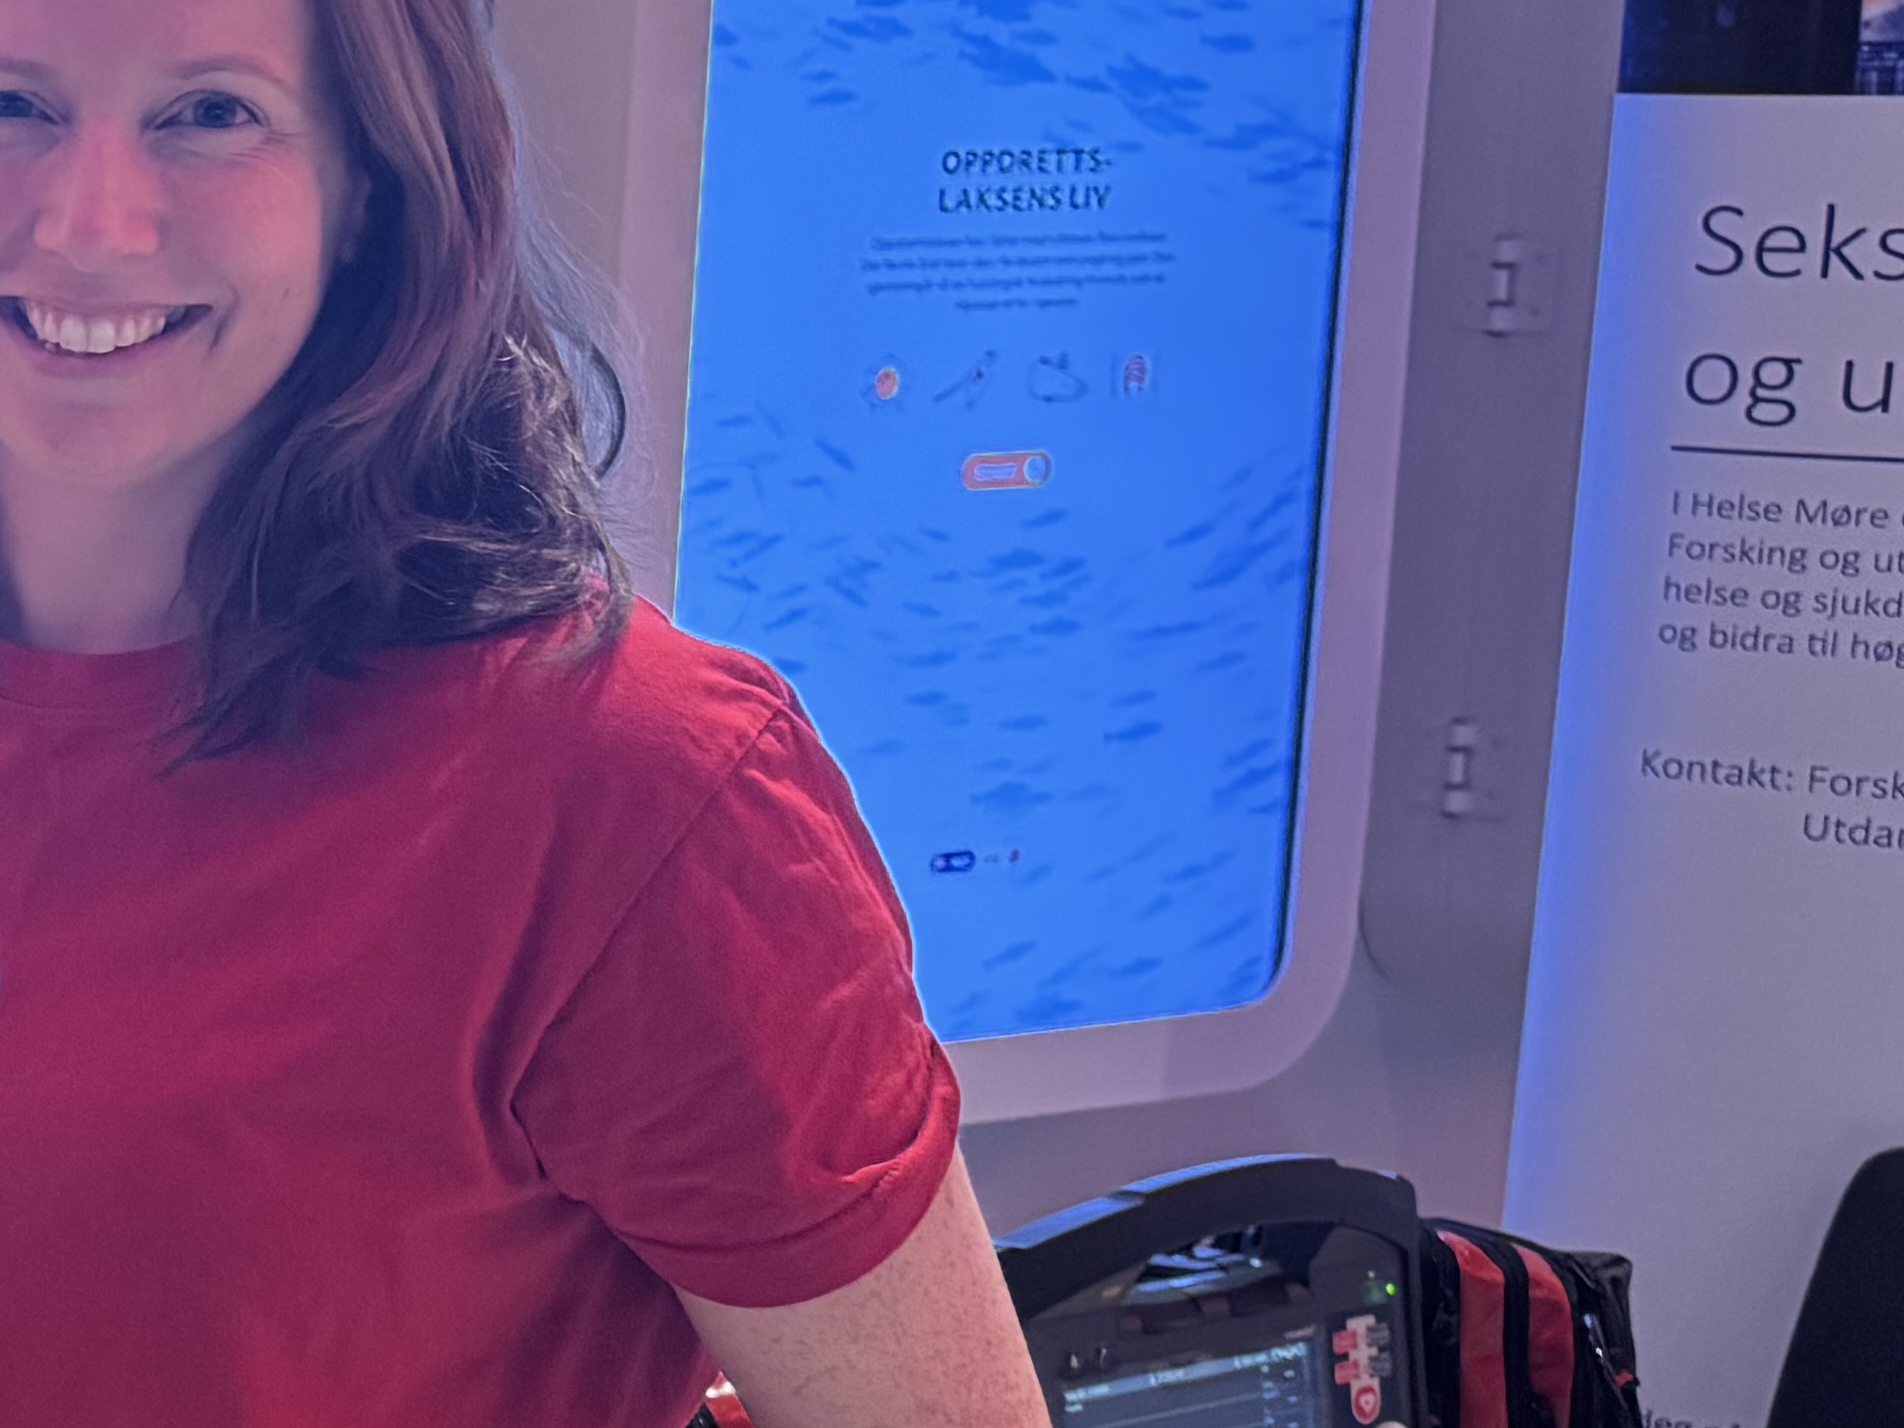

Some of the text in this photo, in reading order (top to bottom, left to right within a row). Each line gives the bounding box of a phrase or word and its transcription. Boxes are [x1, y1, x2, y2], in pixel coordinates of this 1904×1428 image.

[938, 185, 1112, 214] LAKSENS LIV
[1685, 352, 1803, 427] og
[1671, 490, 1890, 529] I Helse Møre
[1667, 532, 1809, 573] Forsking
[1818, 549, 1861, 578] og
[1662, 576, 1904, 620] helse og sjukd
[1657, 624, 1697, 653] og
[1708, 620, 1795, 655] bidra
[1807, 630, 1838, 658] til
[1640, 747, 1904, 801] Kontakt: Forsk
